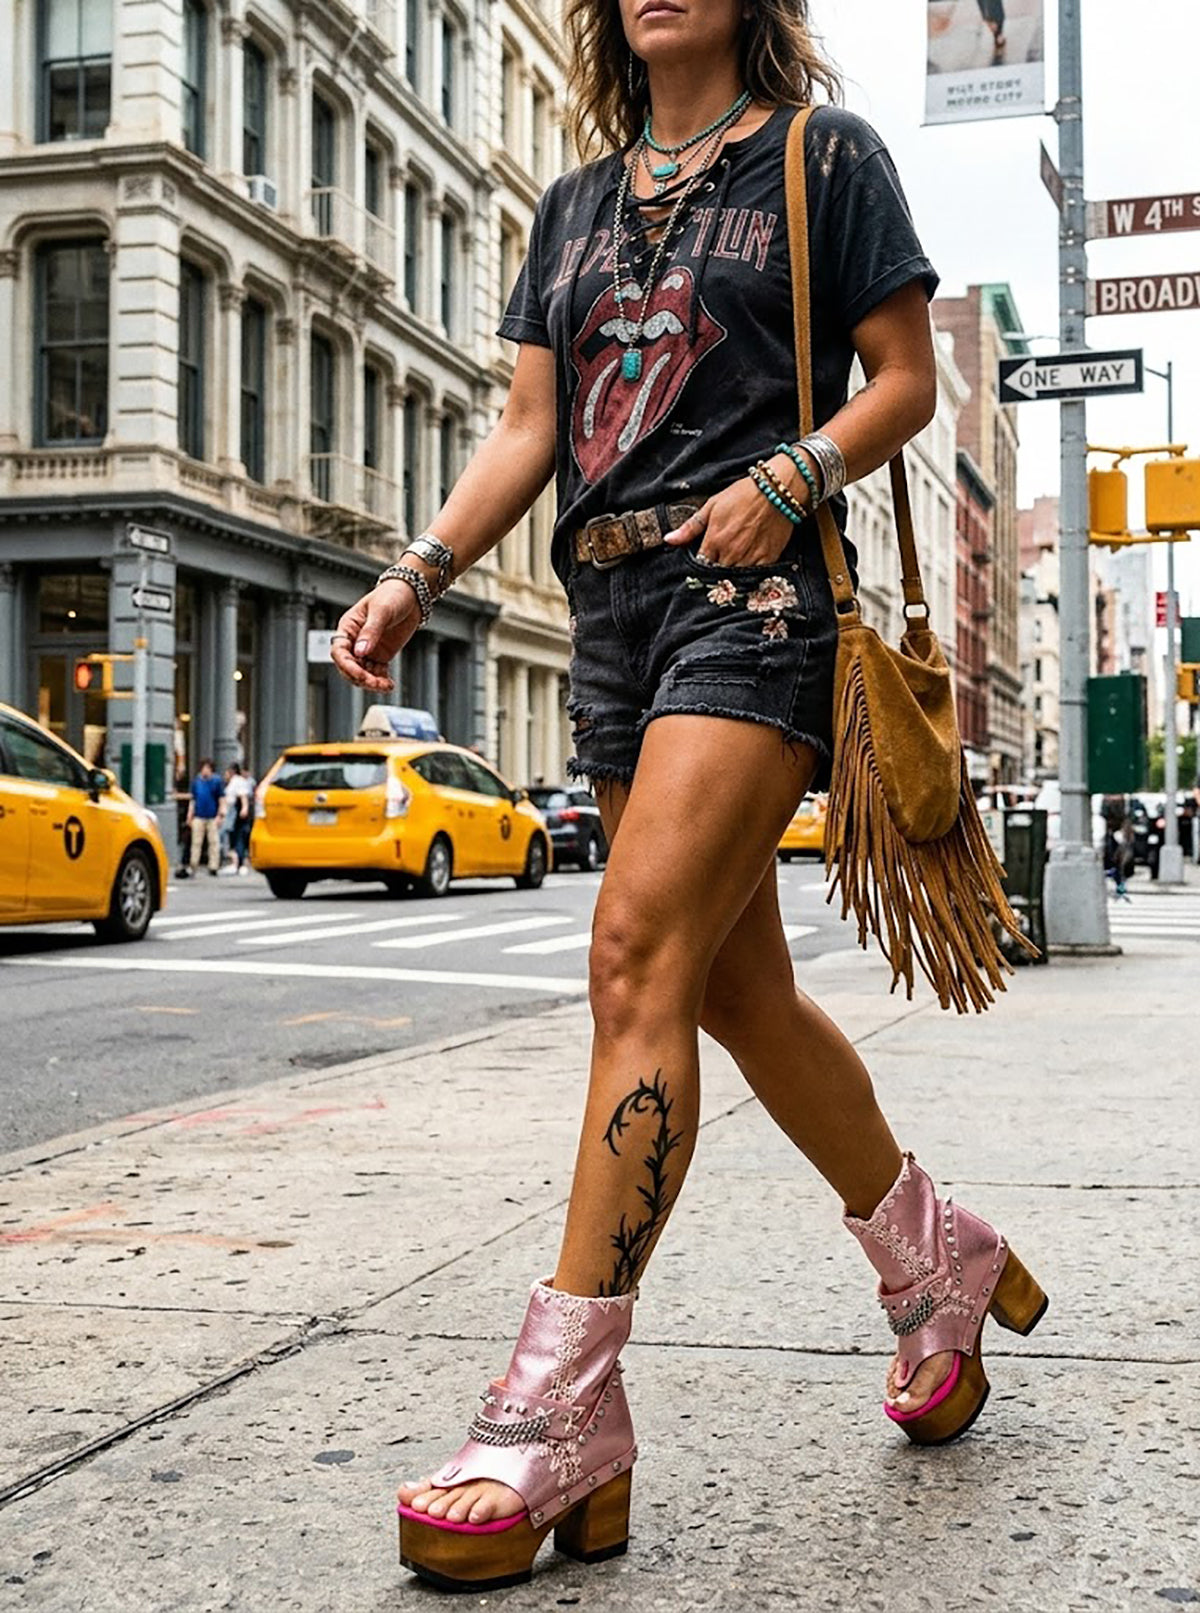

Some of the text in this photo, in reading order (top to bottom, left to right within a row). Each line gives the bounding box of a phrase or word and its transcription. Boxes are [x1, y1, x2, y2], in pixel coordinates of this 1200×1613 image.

[1113, 203, 1135, 232] W
[1144, 198, 1183, 230] 4TH
[1019, 363, 1124, 389] ONE WAY
